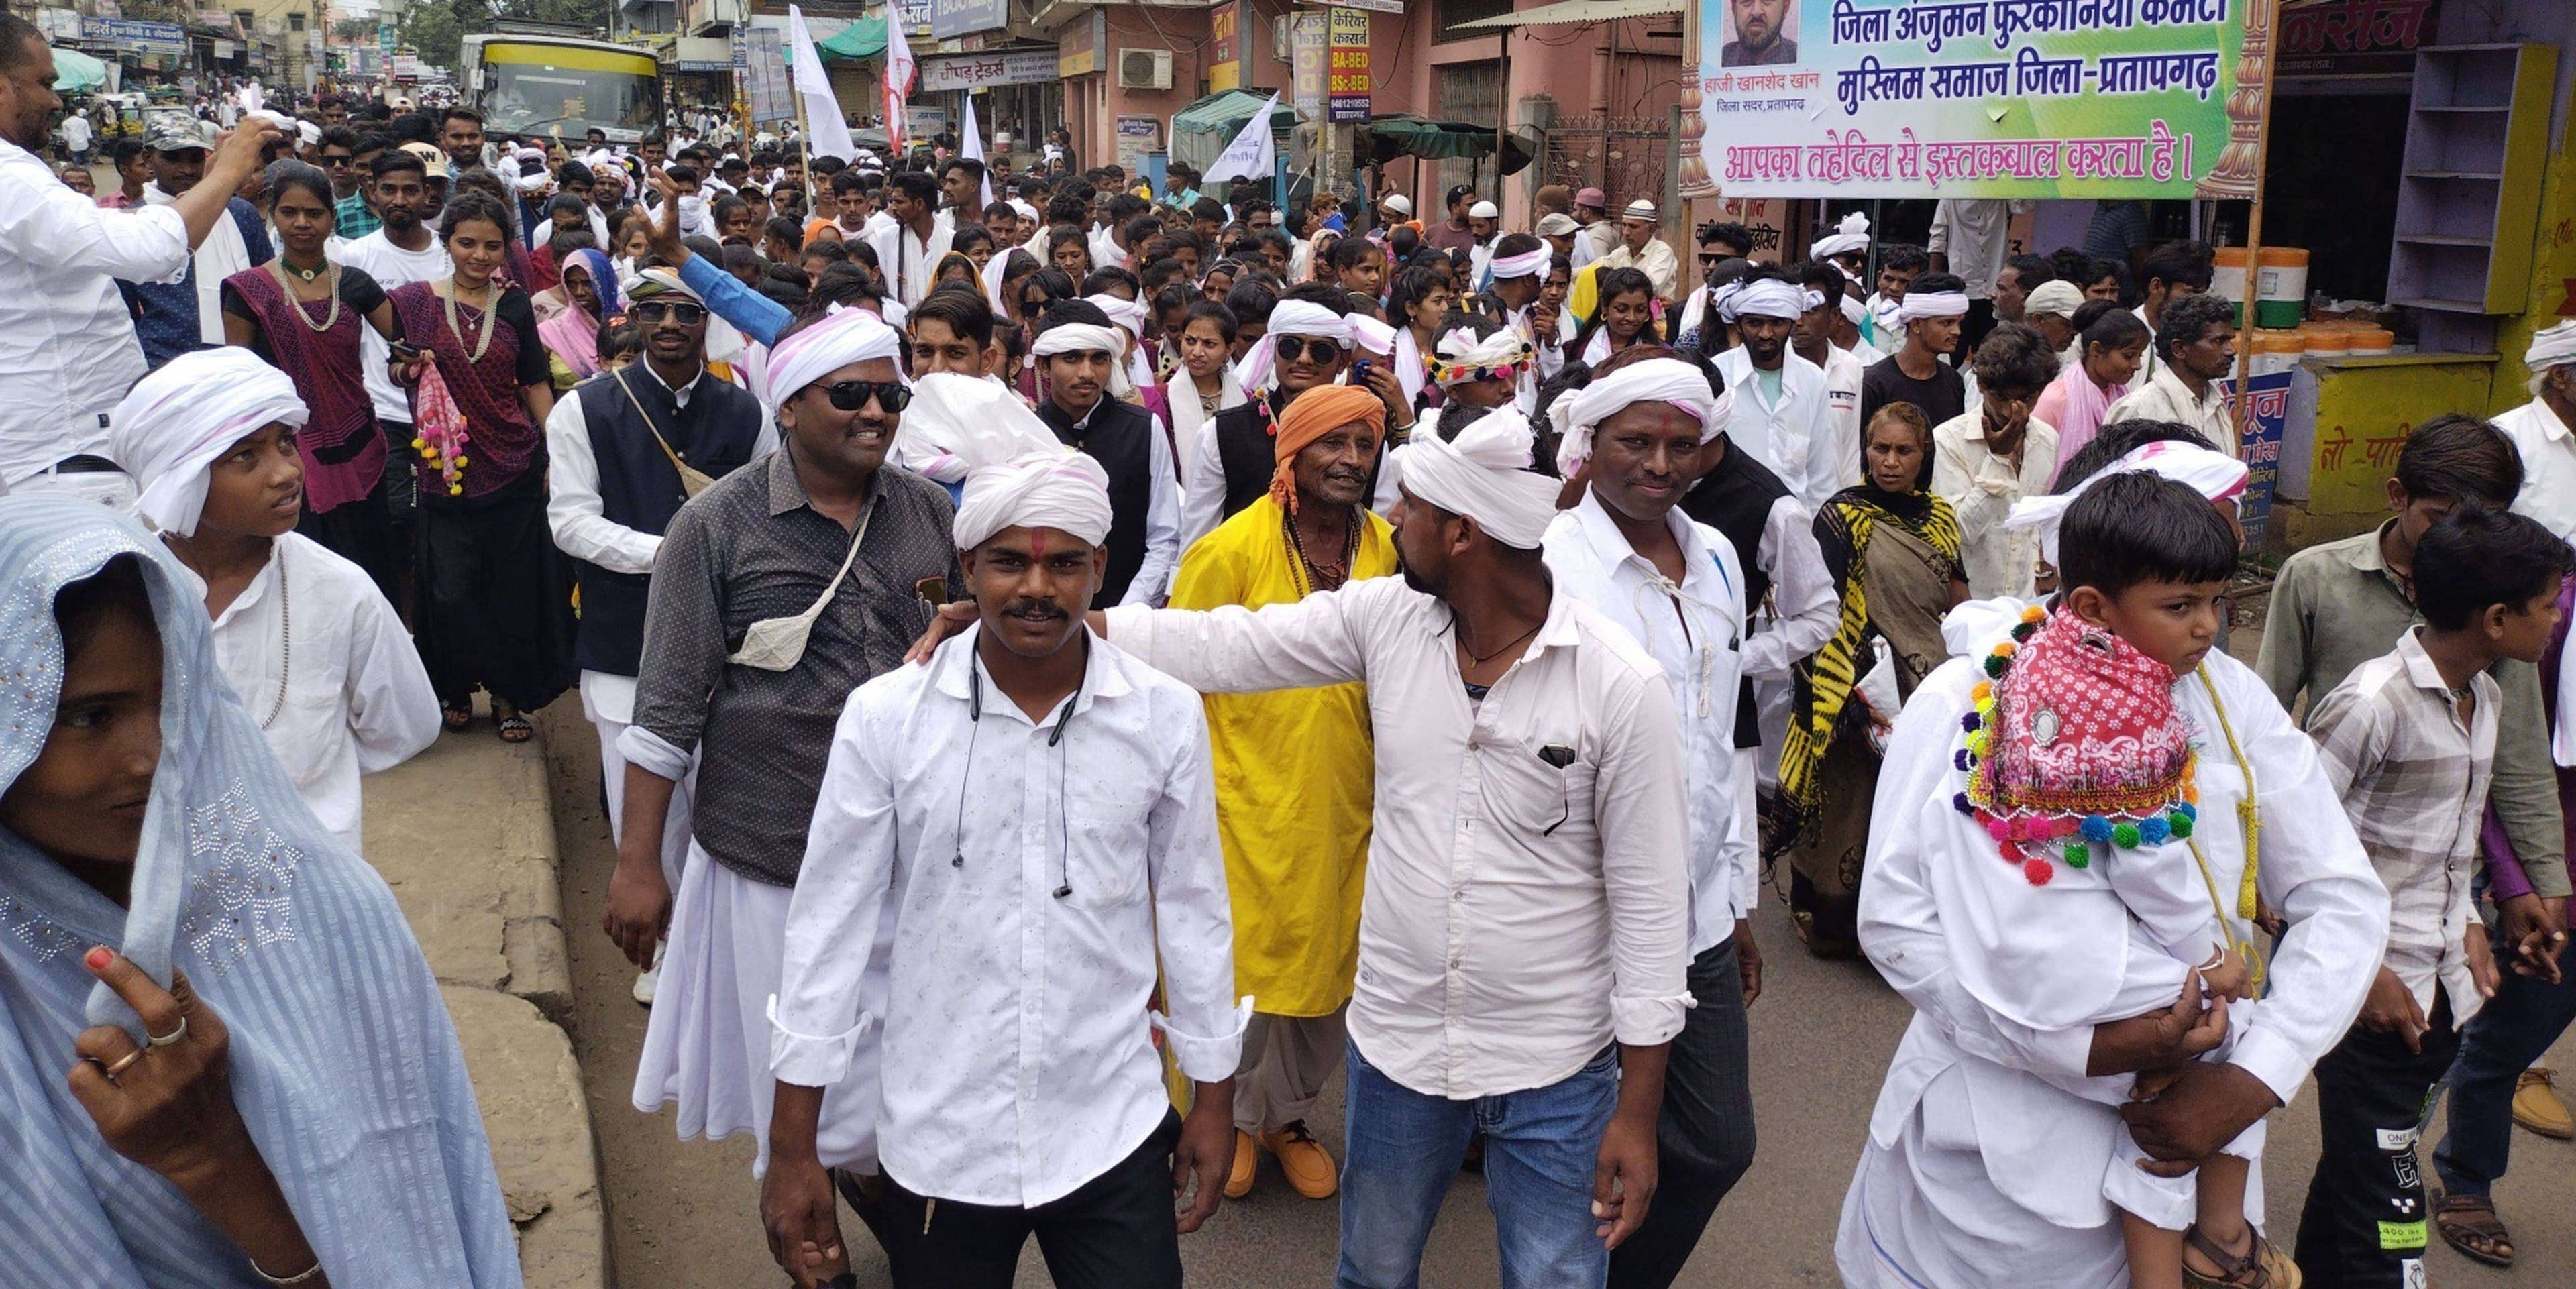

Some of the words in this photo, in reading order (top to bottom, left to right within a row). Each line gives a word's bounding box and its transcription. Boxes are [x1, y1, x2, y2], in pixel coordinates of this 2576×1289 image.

[1334, 10, 1366, 27] केरियर
[1833, 0, 1891, 44] जिला
[1895, 0, 1989, 52] अंजुमन
[1334, 30, 1366, 44] कन्सर्न
[1332, 52, 1368, 68] BA-BED
[975, 59, 1004, 82] ट्रेडर्स
[1331, 75, 1368, 91] BSc-BED
[1705, 72, 1733, 93] हाजी
[1837, 55, 1925, 115] मुस्लिम
[1931, 63, 2010, 99] समाज
[1717, 98, 1740, 113] जिला
[417, 150, 436, 162] W
[1725, 145, 1803, 181] आपका
[1896, 127, 1920, 181] से
[1925, 139, 2061, 188] इस्तकबाल
[2066, 137, 2146, 180] करता
[2250, 435, 2281, 465] प्रेस
[2321, 425, 2354, 471] नो
[2387, 1133, 2407, 1142] ONE
